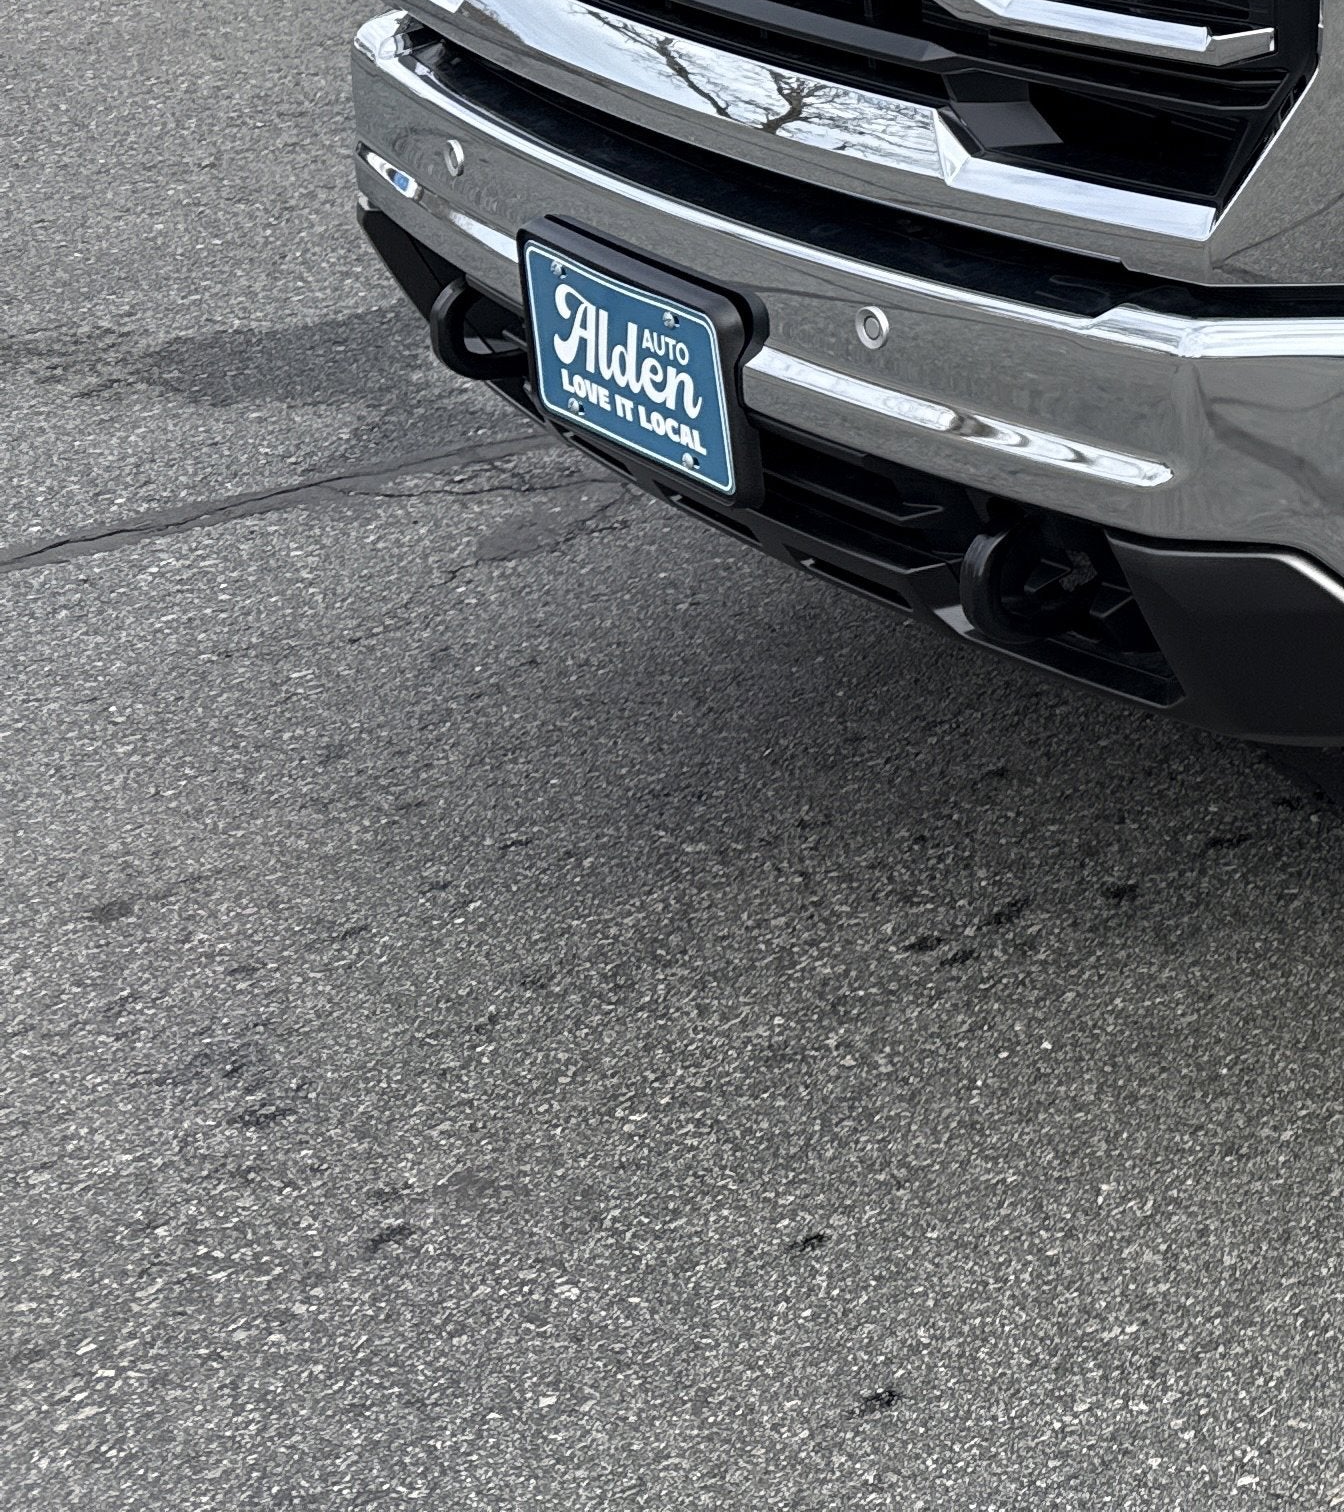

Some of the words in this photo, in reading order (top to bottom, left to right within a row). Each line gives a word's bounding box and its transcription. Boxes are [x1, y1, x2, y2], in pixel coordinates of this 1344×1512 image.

[553, 283, 703, 419] Alden
[642, 328, 689, 366] AUTO
[560, 369, 612, 412] LOVE
[614, 394, 635, 422] IT
[637, 404, 708, 456] LOCAL
